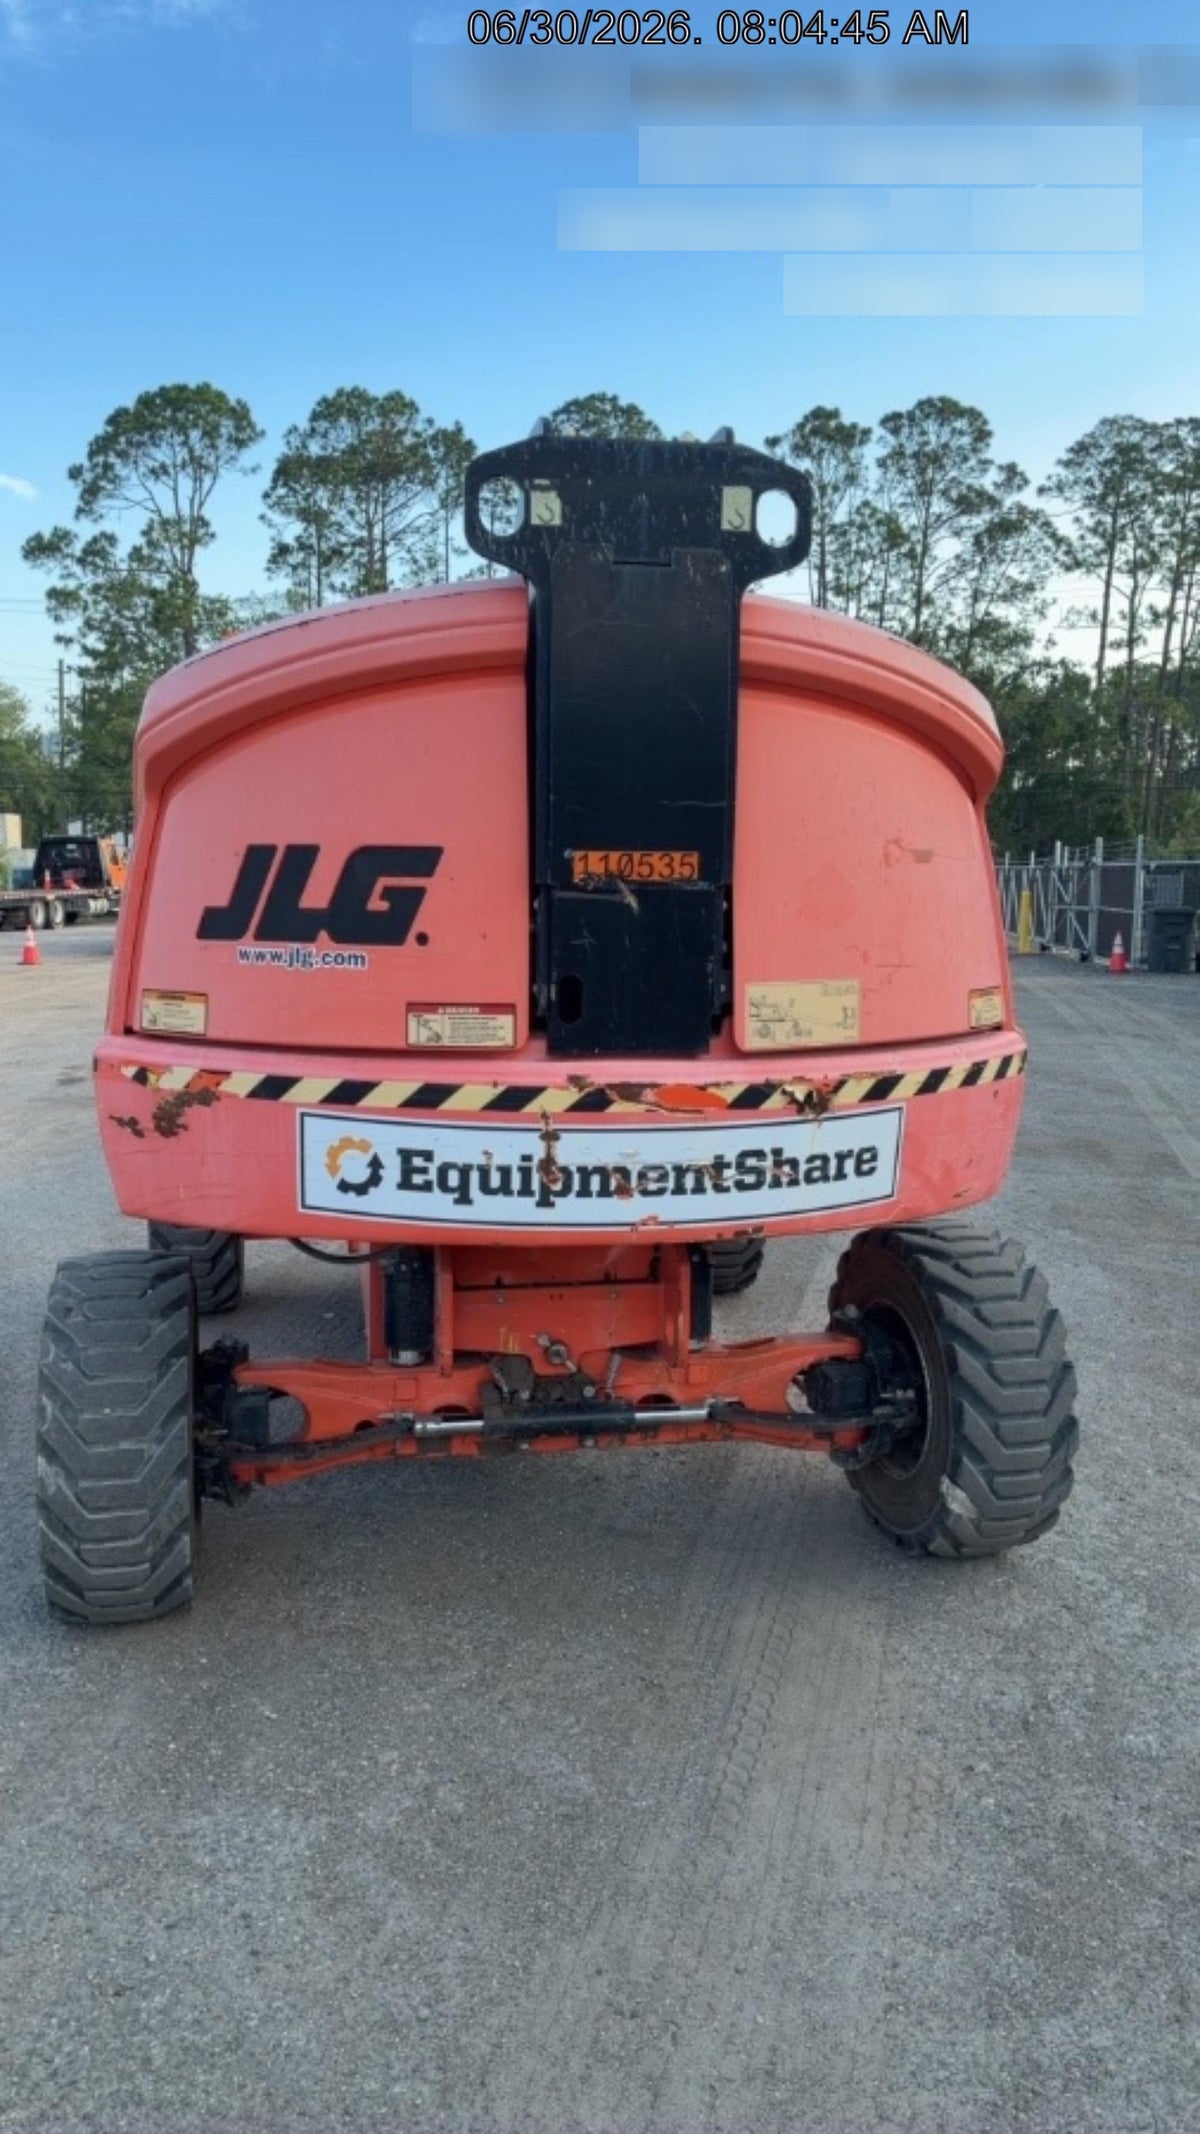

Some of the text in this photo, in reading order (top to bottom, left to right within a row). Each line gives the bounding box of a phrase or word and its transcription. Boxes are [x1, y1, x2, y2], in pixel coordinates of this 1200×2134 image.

[577, 852, 697, 879] 110535
[238, 945, 366, 969] www.jlg.com
[396, 1144, 879, 1208] EquipmentShare
